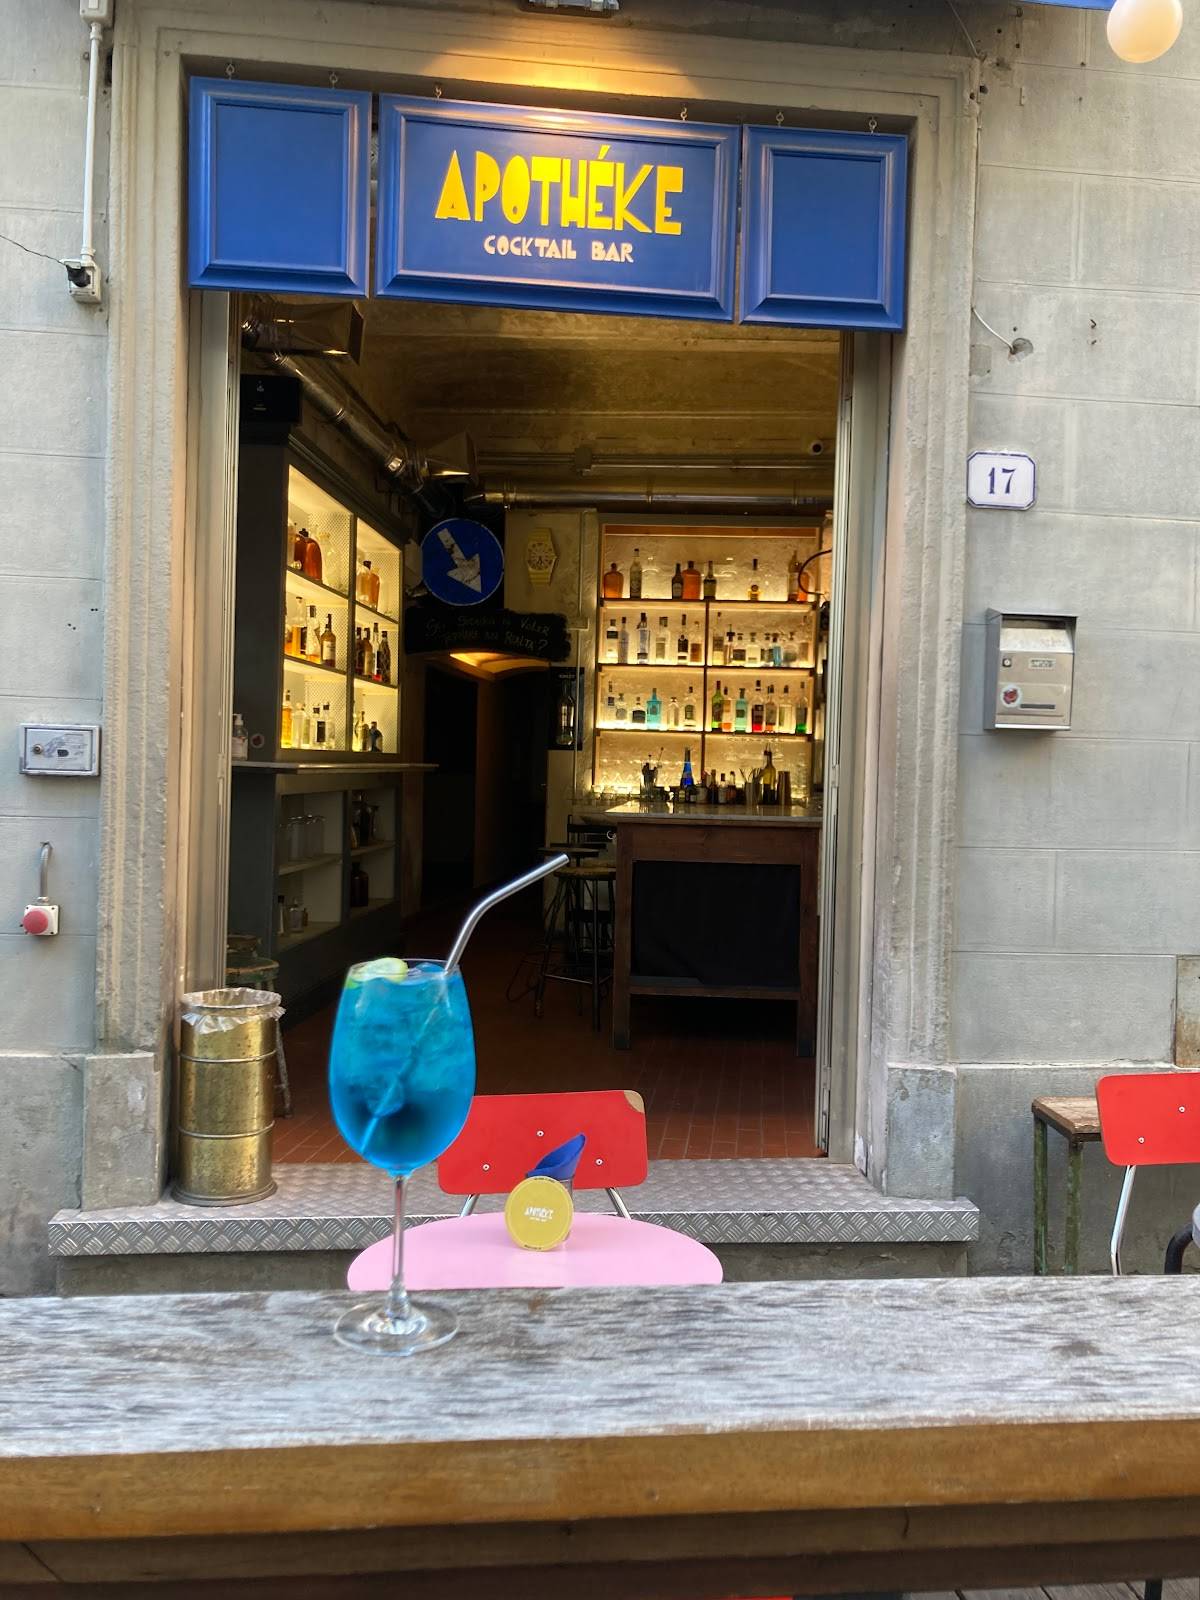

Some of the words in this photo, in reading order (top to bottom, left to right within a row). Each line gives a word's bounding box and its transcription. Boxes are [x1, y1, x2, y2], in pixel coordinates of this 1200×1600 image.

[435, 145, 683, 235] APOTHÉKE
[483, 234, 577, 260] COCKTAIL
[591, 241, 634, 263] BAR
[988, 467, 1016, 494] 17
